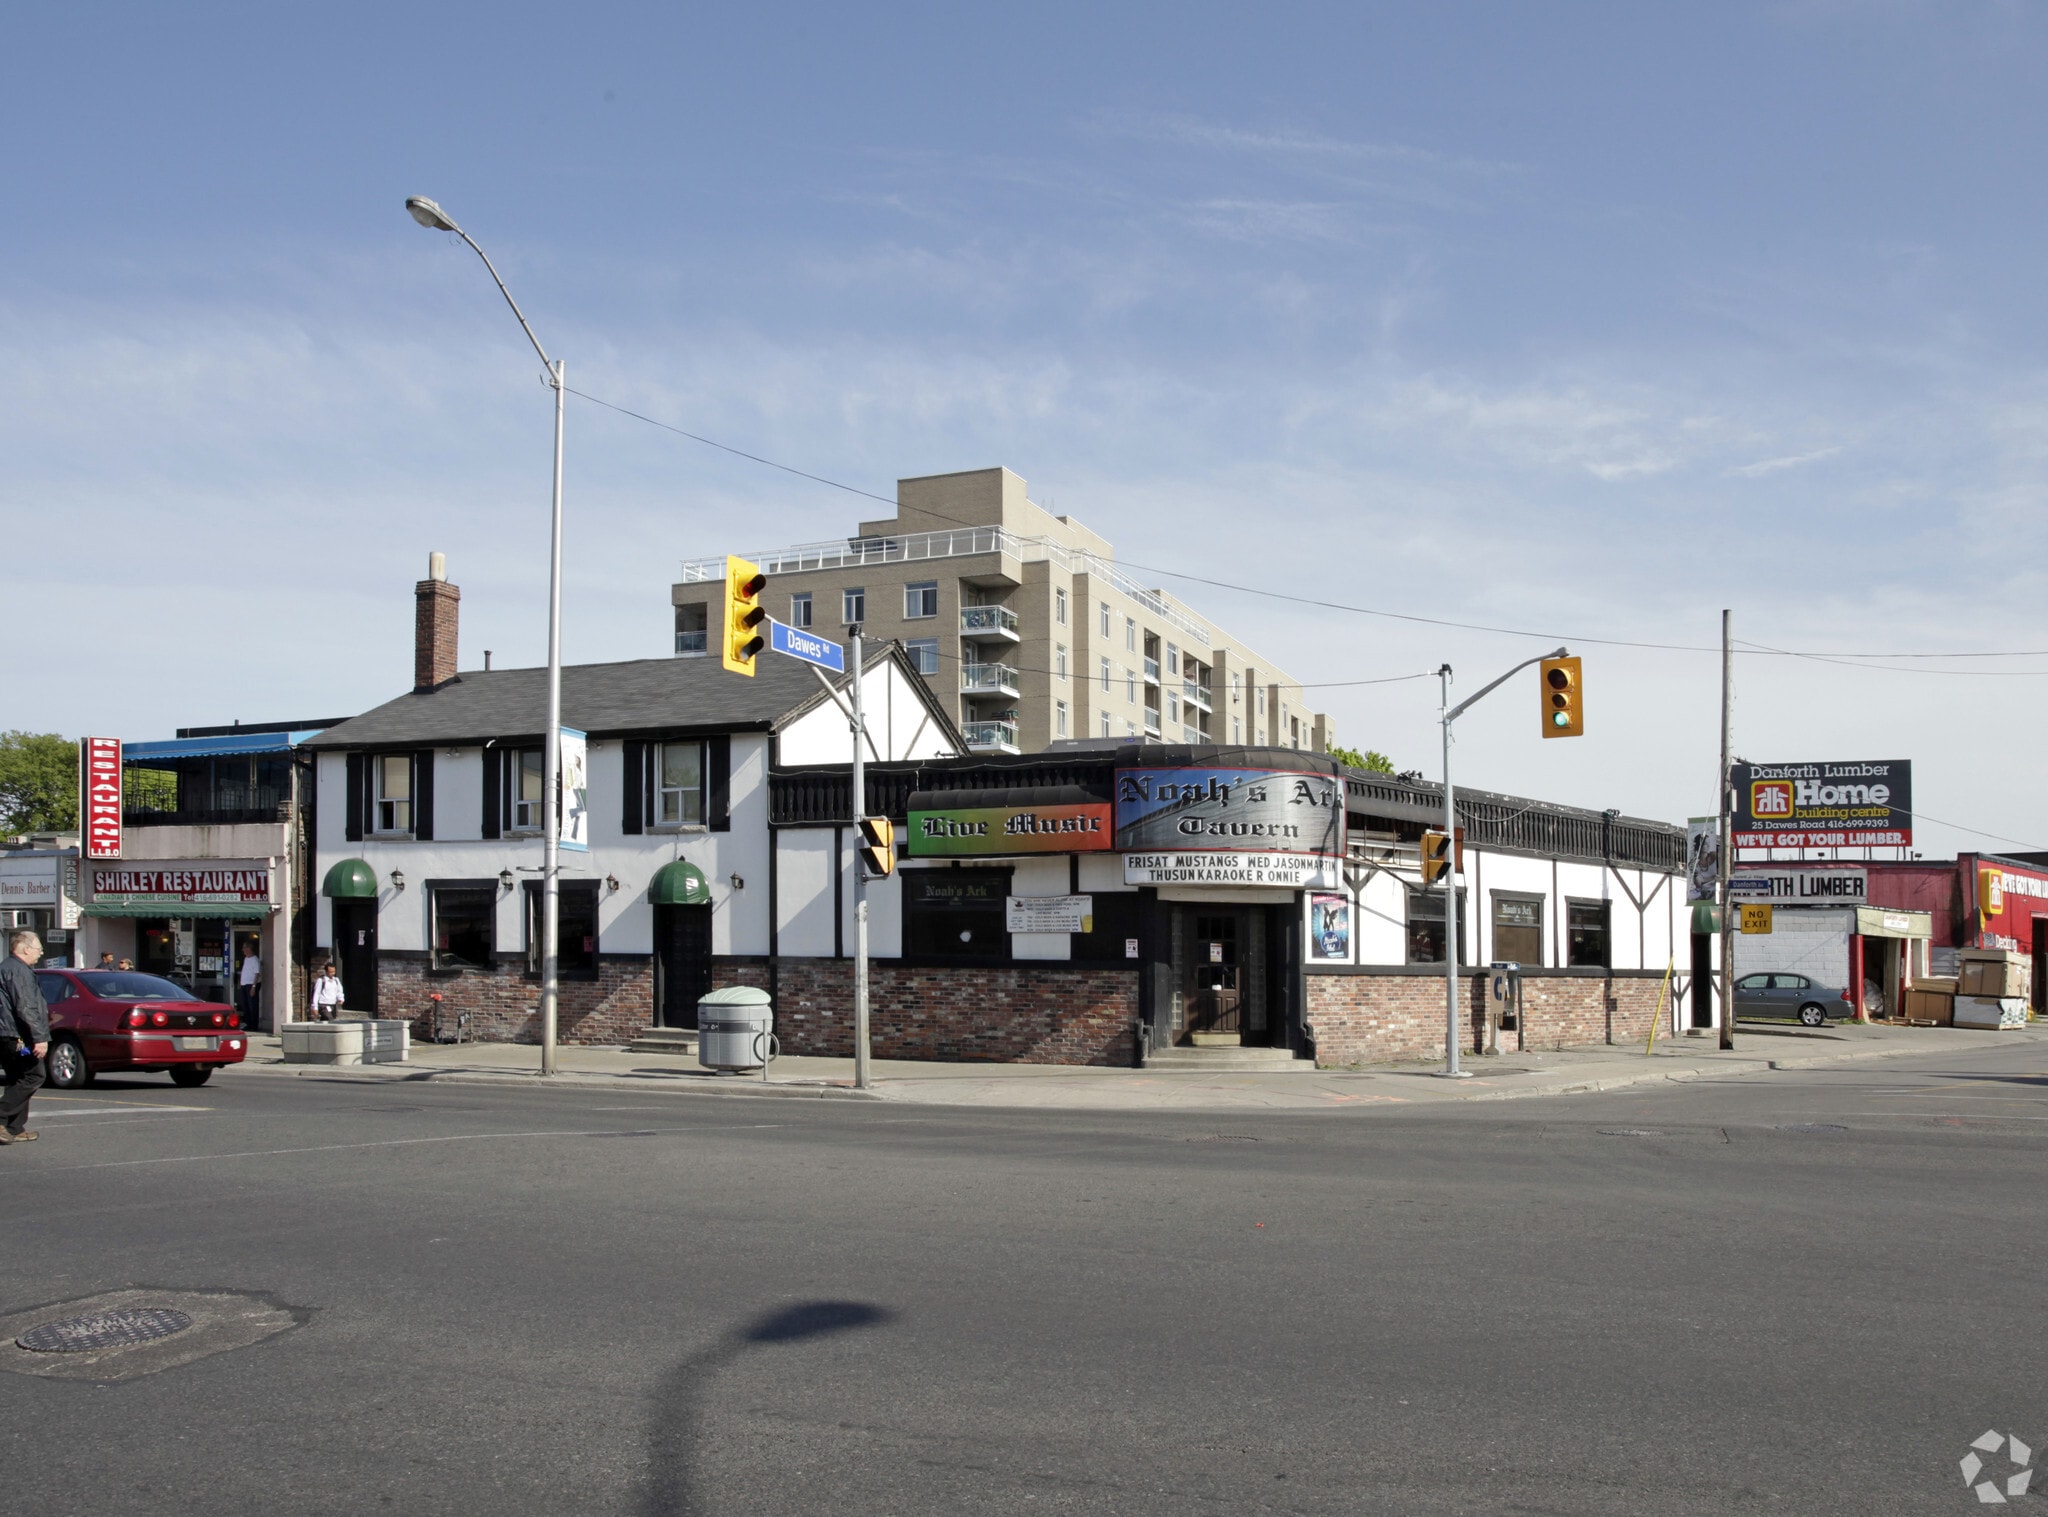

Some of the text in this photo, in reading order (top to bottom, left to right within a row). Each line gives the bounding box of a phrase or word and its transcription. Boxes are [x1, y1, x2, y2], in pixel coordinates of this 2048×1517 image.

[787, 630, 830, 659] Dawes Rd
[1750, 763, 1890, 779] Danforth Lumber
[91, 738, 119, 847] RESTAURANT
[1118, 775, 1344, 810] Noah's Ark
[1794, 779, 1890, 806] Home
[1795, 805, 1890, 821] building centre
[920, 812, 1102, 839] Live Music
[1176, 815, 1299, 839] Tavern
[1751, 819, 1889, 830] 25 Dawes Road 416-699-9393
[1736, 832, 1907, 847] WE'VE GOT YOUR LUMBER.
[1175, 856, 1239, 868] MUSTANGS
[1247, 857, 1271, 868] WED
[96, 871, 268, 892] SHIRLEY RESTAURANT
[1199, 869, 1253, 881] KARAOKE
[2, 881, 24, 895] Dennis
[27, 881, 50, 894] Barber
[966, 884, 987, 897] Ark
[1800, 874, 1864, 897] LUMBER
[1748, 910, 1764, 919] NO
[1744, 920, 1768, 929] EXIT
